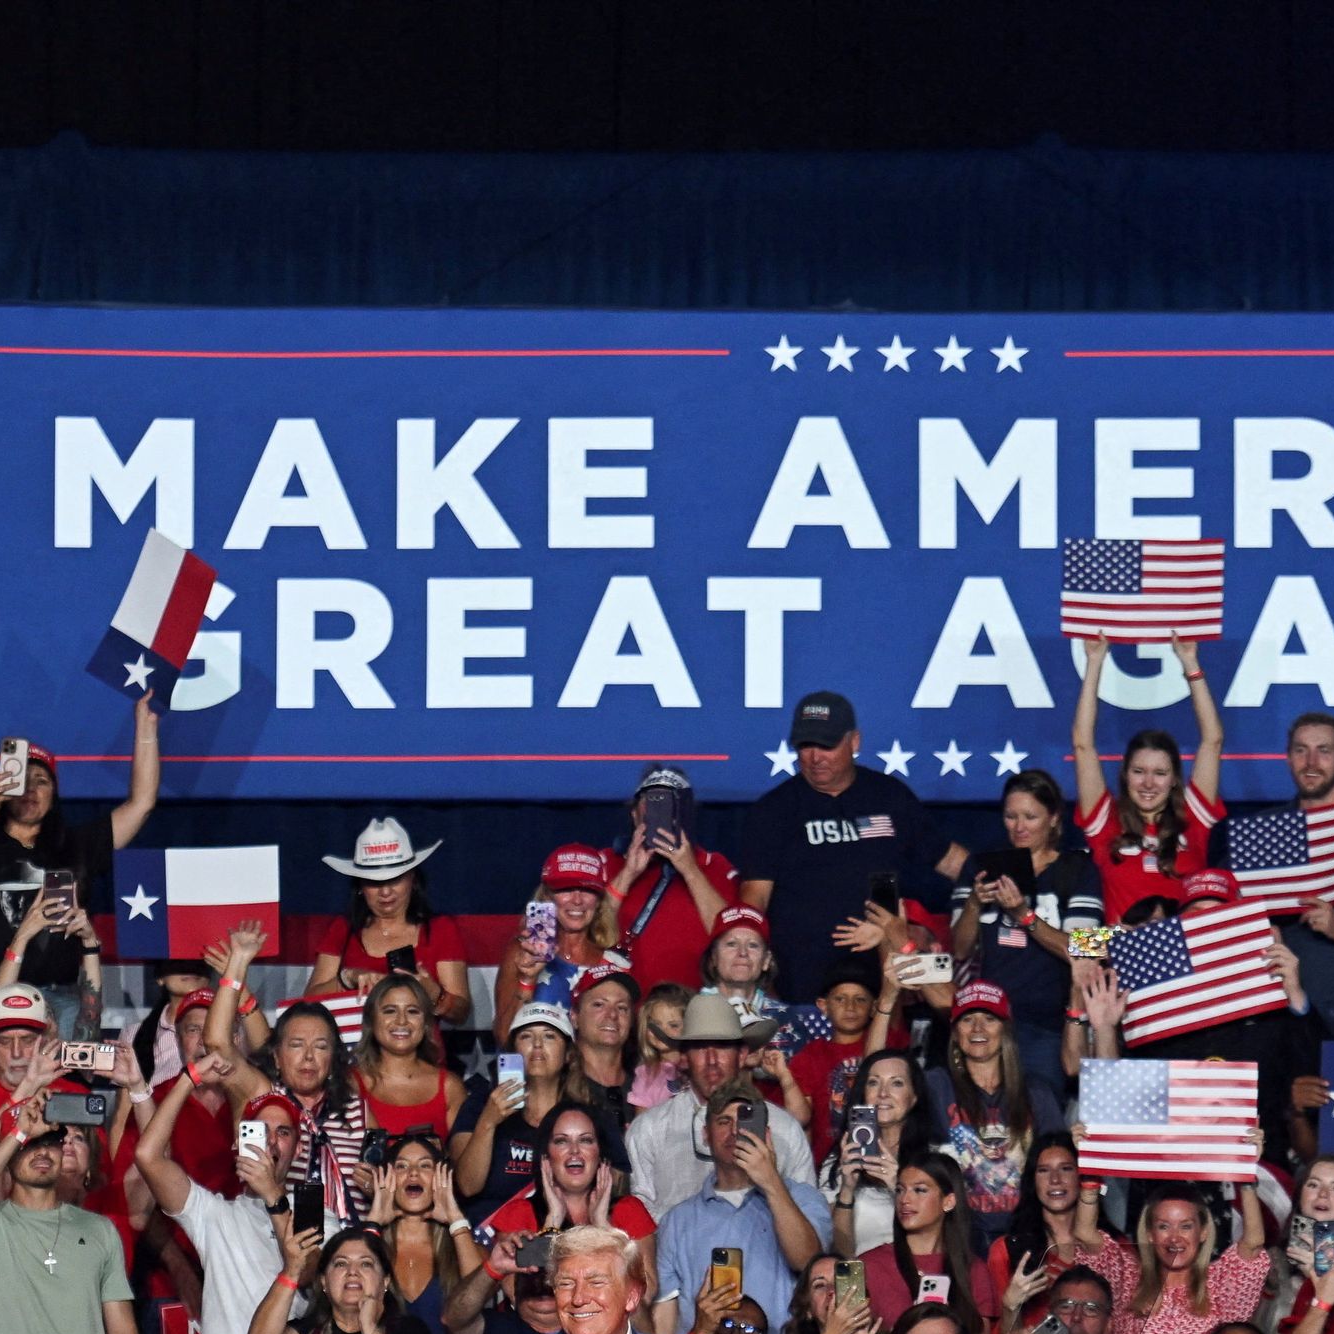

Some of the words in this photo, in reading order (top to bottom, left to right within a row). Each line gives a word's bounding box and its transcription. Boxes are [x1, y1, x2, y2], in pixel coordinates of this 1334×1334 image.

[55, 416, 655, 551] MAKE
[805, 819, 859, 845] USA
[363, 842, 400, 855] TRUMP
[575, 854, 601, 867] AMERICA
[973, 983, 1003, 997] AMERICA
[511, 1146, 534, 1163] WE
